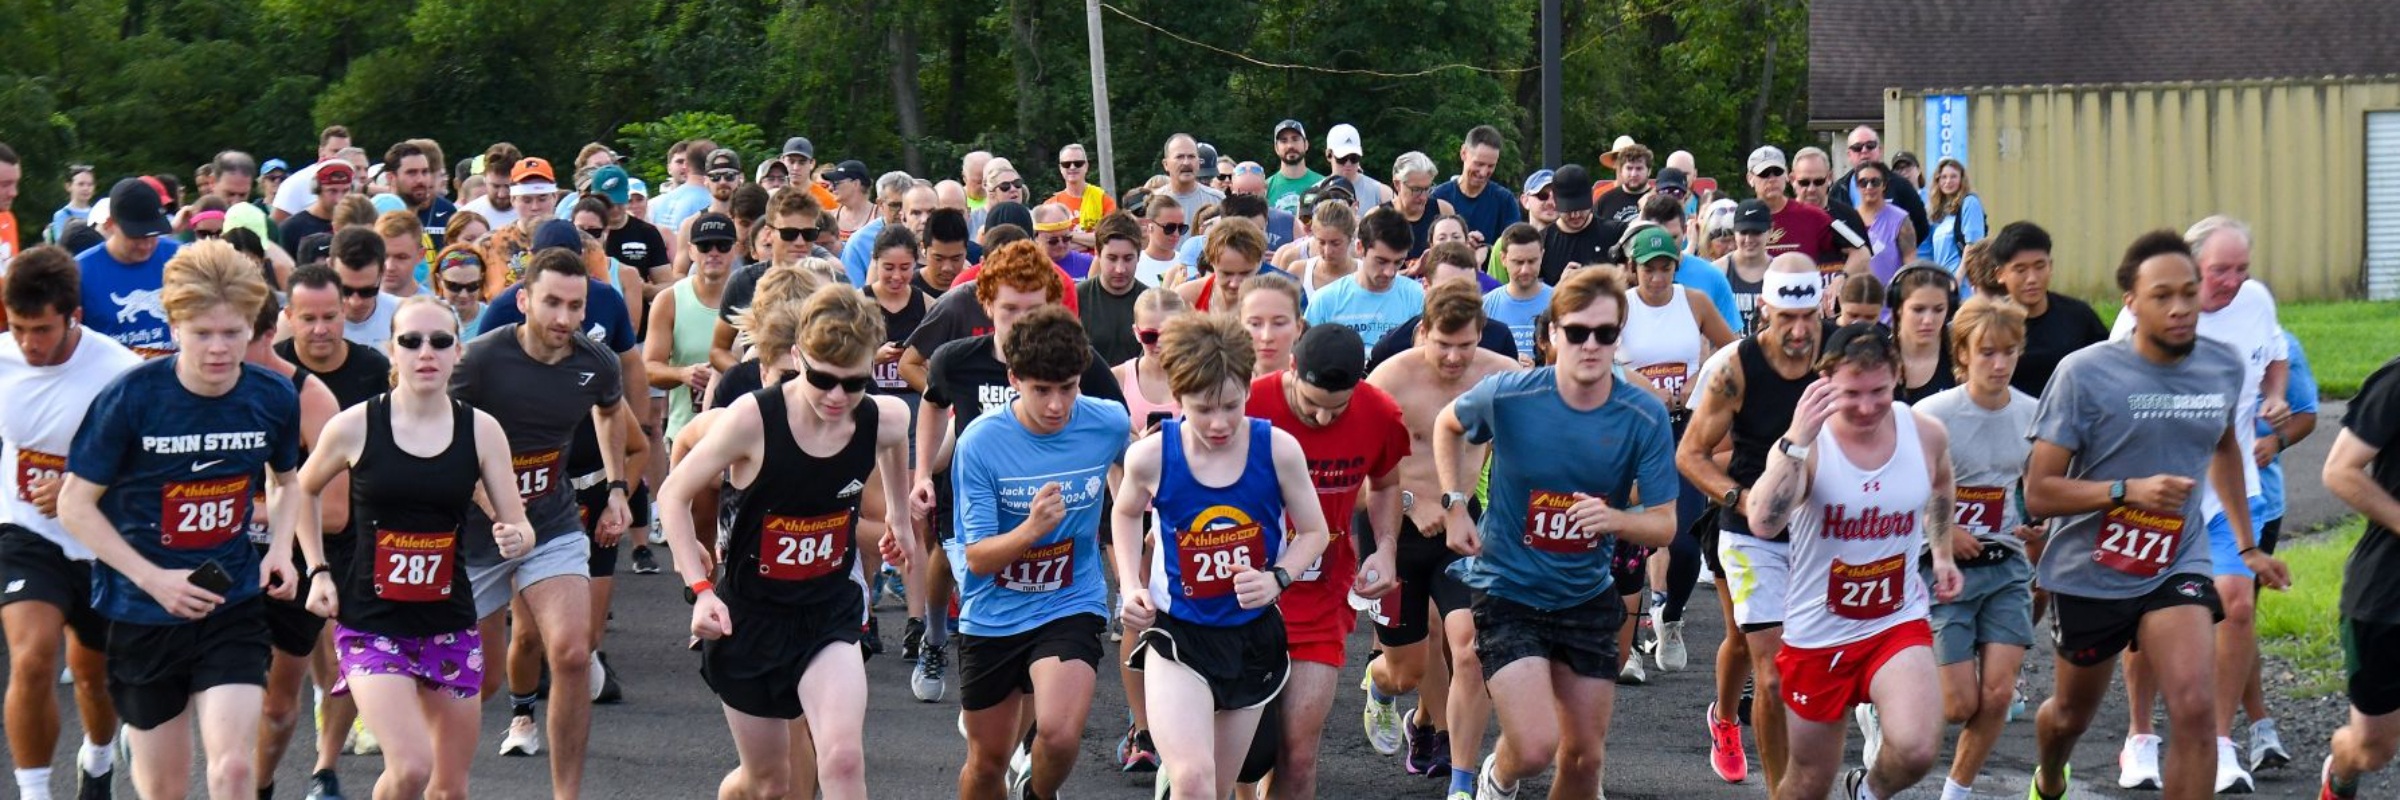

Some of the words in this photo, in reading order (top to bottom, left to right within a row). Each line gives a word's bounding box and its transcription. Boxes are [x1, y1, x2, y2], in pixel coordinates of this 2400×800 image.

[876, 362, 904, 380] 16
[978, 385, 1021, 402] REIG
[1651, 376, 1685, 395] 185
[142, 433, 201, 454] PENN
[203, 431, 267, 451] STATE
[520, 467, 550, 495] 15
[1000, 486, 1024, 497] Jack
[177, 498, 235, 532] 285
[766, 517, 828, 533] Athletic
[1820, 502, 1915, 541] Hatters
[1954, 502, 1986, 526] 72
[379, 533, 436, 549] Athletic
[775, 533, 834, 566] 284
[1180, 531, 1238, 547] Athletic
[2101, 521, 2174, 564] 2171
[388, 553, 443, 585] 287
[1193, 545, 1251, 582] 286
[1841, 577, 1892, 607] 271
